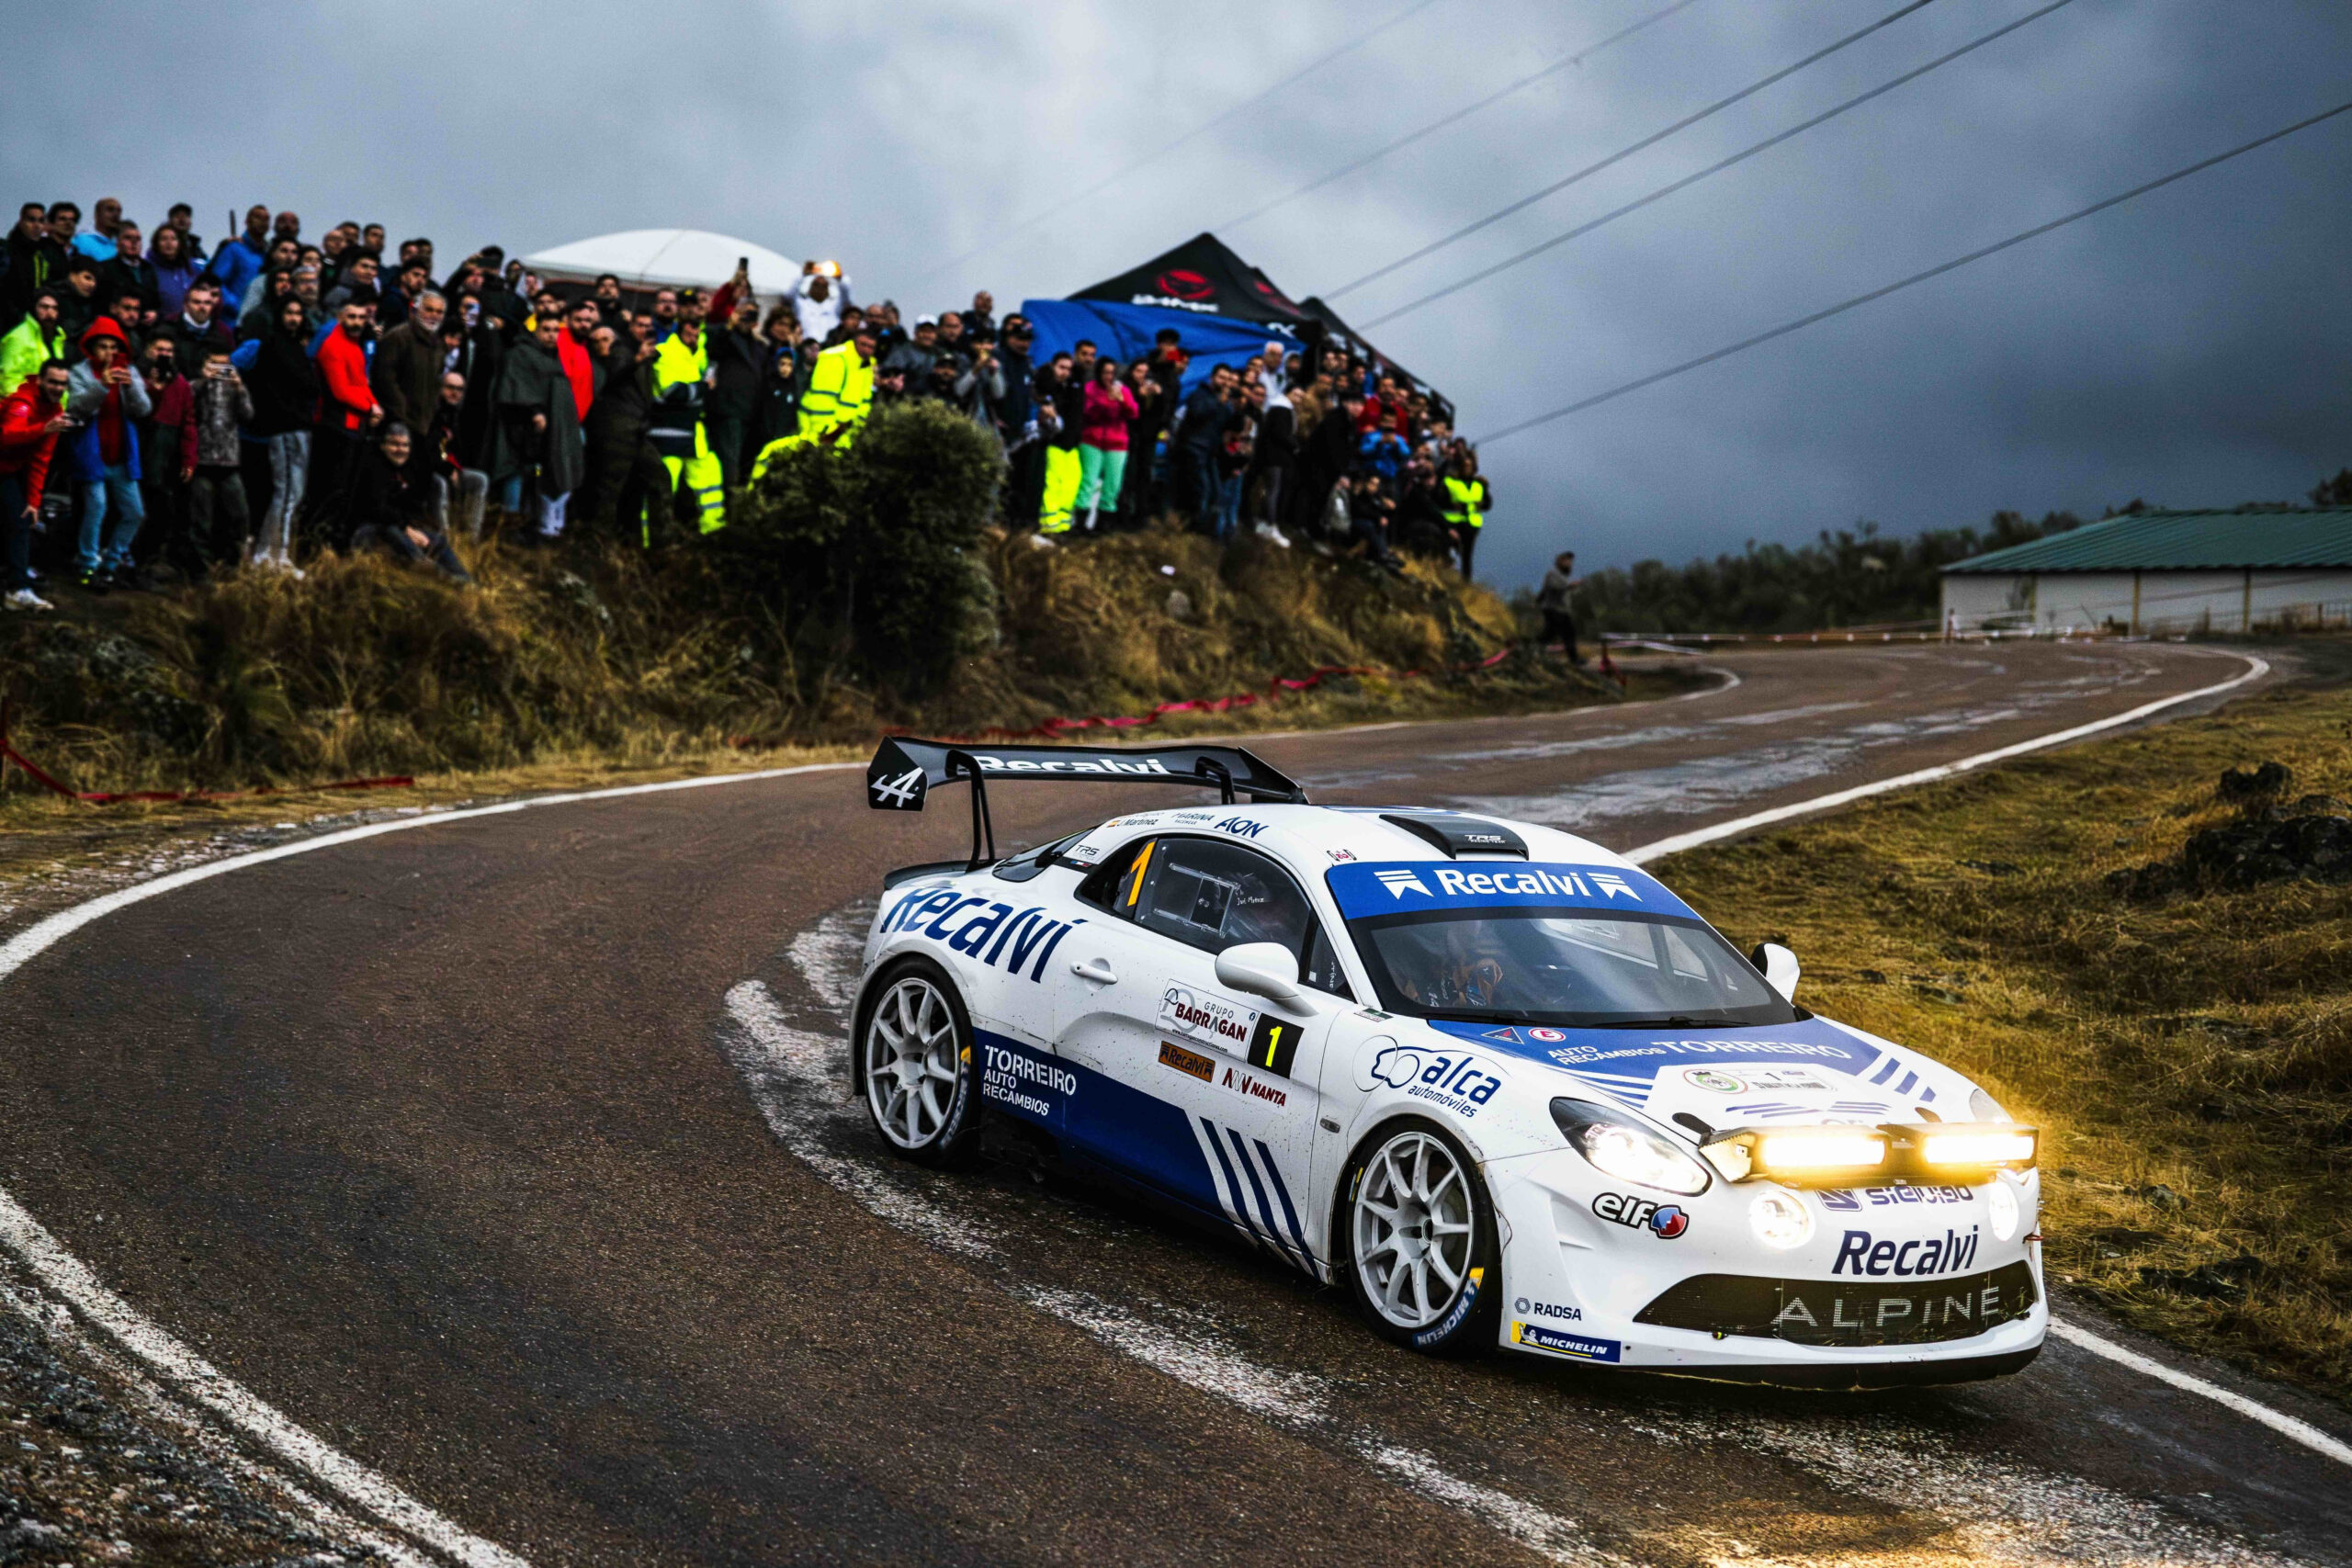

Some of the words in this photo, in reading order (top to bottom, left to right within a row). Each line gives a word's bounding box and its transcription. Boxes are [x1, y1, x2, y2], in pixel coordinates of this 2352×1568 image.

[970, 756, 1172, 774] Recalvi
[1214, 817, 1270, 839] AON
[1075, 844, 1101, 856] TRS
[1127, 840, 1157, 908] 1
[1433, 869, 1593, 897] Recalvi
[879, 886, 1089, 984] Recalvi
[1174, 1002, 1248, 1043] BARRAGAN
[1204, 1001, 1235, 1019] GRUPO
[1265, 1025, 1283, 1068] 1
[1547, 1045, 1598, 1059] AUTO
[1556, 1047, 1668, 1066] RECAMBIOS
[1650, 1040, 1852, 1059] TORREIRO
[984, 1044, 1077, 1097] TORREIRO
[1169, 1047, 1205, 1075] Recalvi
[983, 1068, 1017, 1089] AUTO
[1420, 1056, 1502, 1106] alca
[982, 1082, 1050, 1117] RECAMBIOS
[1250, 1082, 1287, 1107] NANTA
[1408, 1085, 1477, 1118] automóviles
[1593, 1193, 1657, 1228] elf
[1831, 1224, 1979, 1277] Recalvi
[1417, 1295, 1470, 1346] MICHELIN
[1533, 1302, 1582, 1322] RADSA
[1770, 1286, 1999, 1328] ALPINE
[1540, 1335, 1608, 1355] MICHELIN
